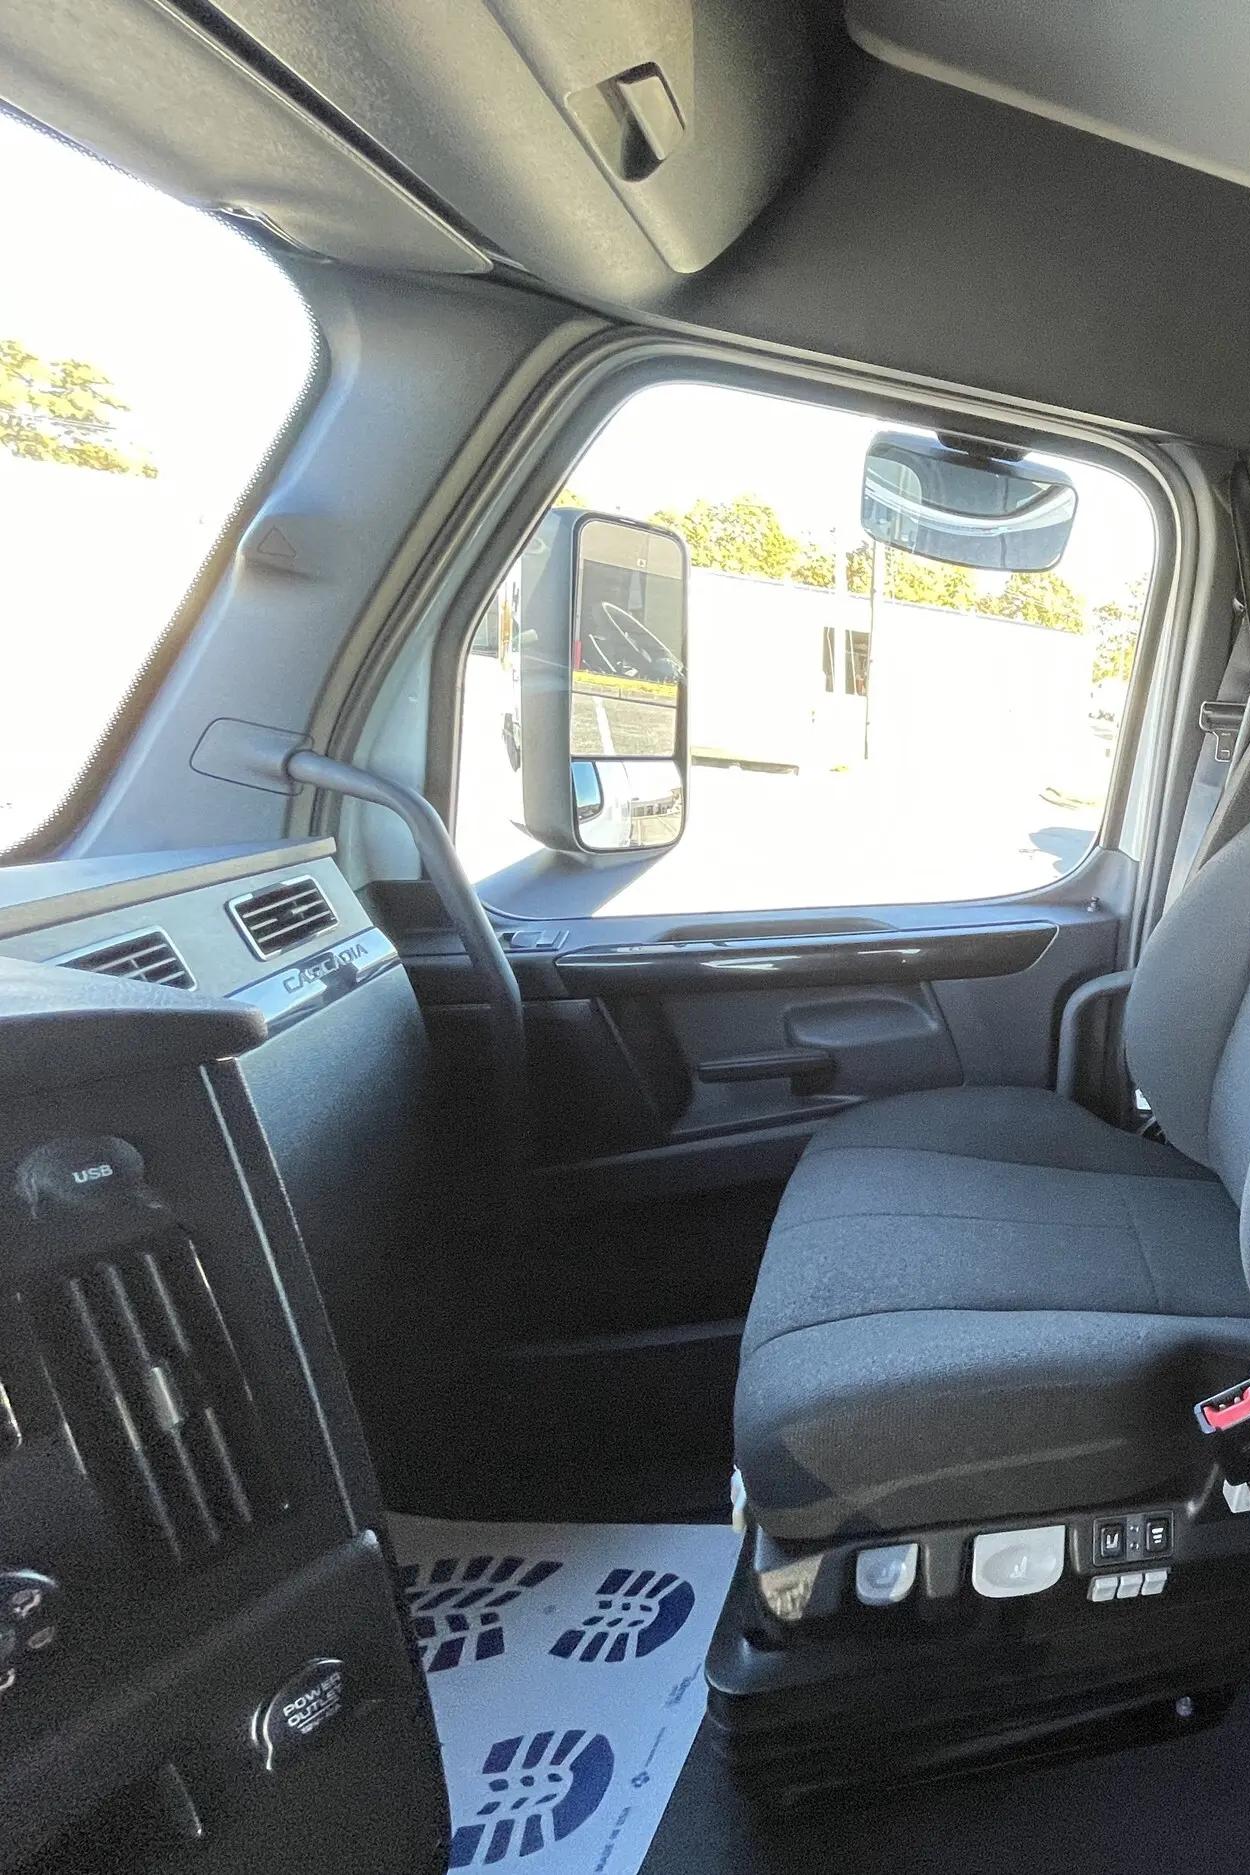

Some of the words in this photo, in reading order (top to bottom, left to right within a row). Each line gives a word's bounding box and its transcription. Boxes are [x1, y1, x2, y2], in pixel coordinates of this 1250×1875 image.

[283, 943, 369, 994] CASCADIA
[71, 1164, 114, 1184] USB
[282, 1671, 342, 1718] POWER
[287, 1683, 342, 1728] OUTLET
